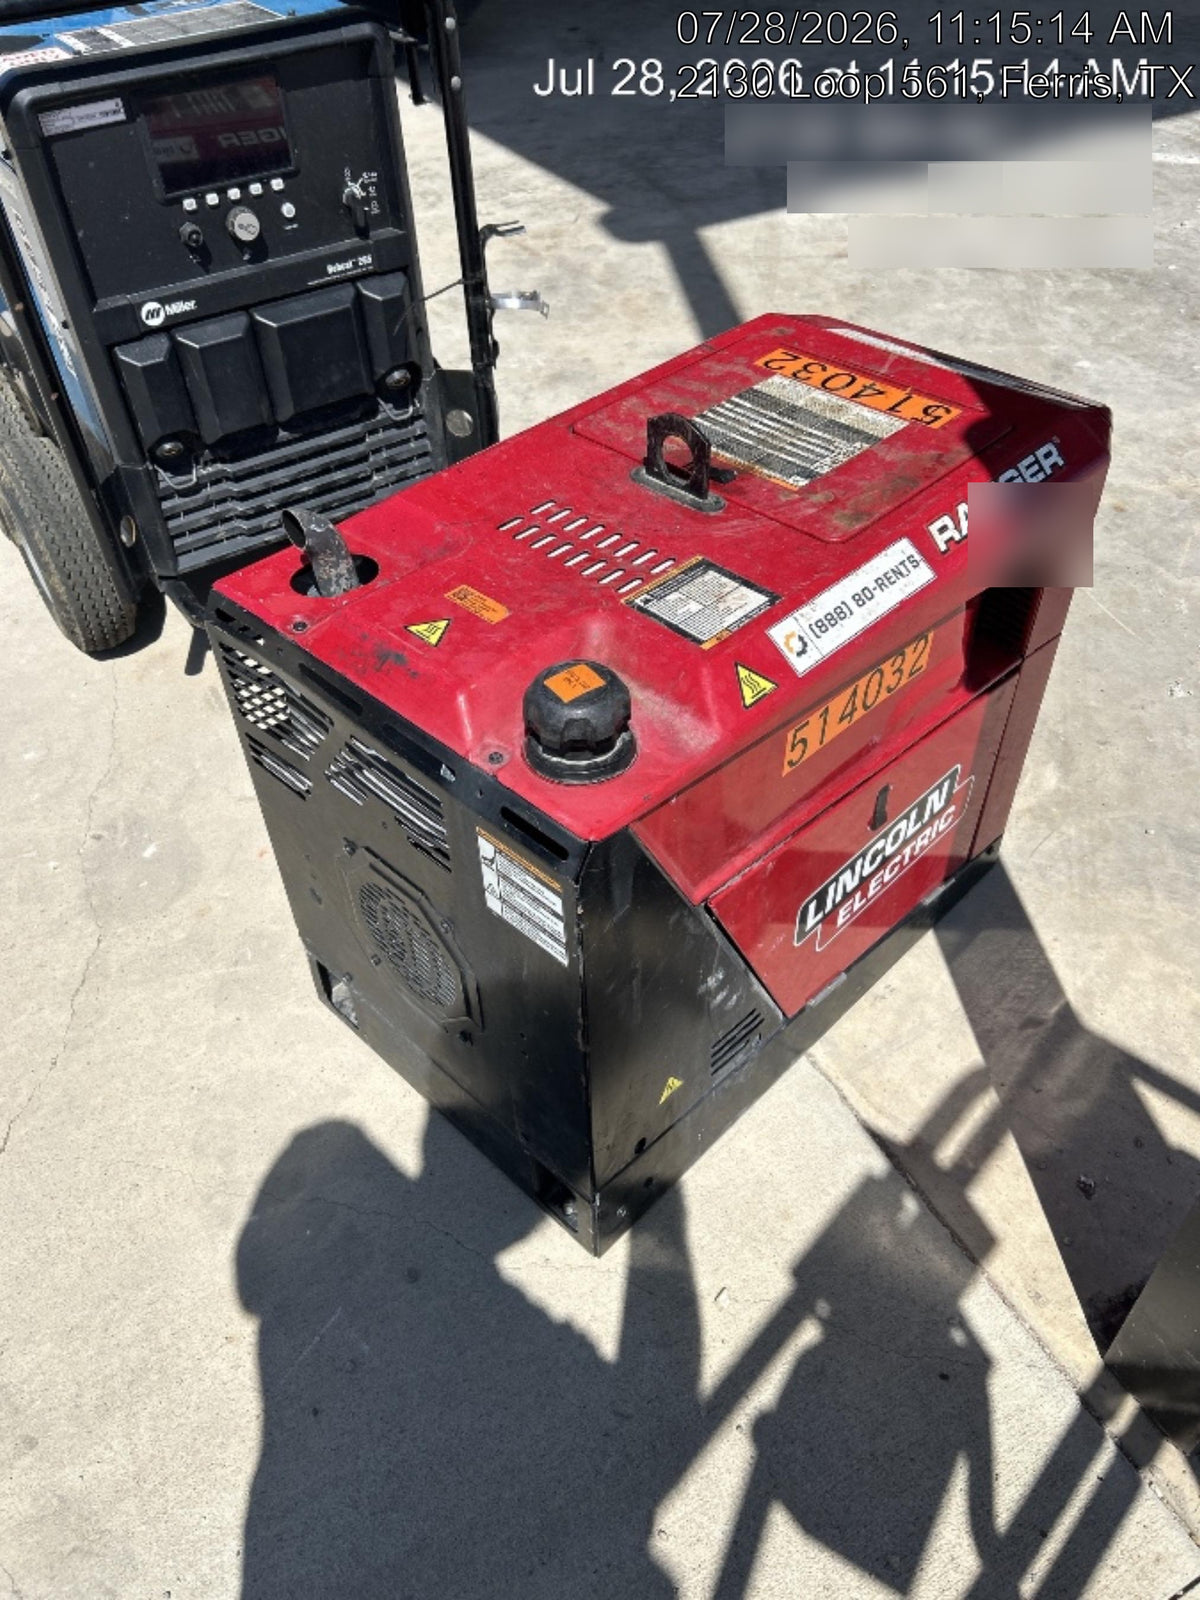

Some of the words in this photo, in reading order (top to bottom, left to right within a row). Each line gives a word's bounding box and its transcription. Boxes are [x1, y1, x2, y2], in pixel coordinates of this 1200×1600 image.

[763, 351, 952, 425] 514032
[809, 601, 854, 639] (888)
[851, 554, 920, 608] 80-RENTS
[787, 631, 929, 768] 514032
[805, 779, 950, 932] LINCOLN
[836, 805, 956, 928] ELECTRIC
